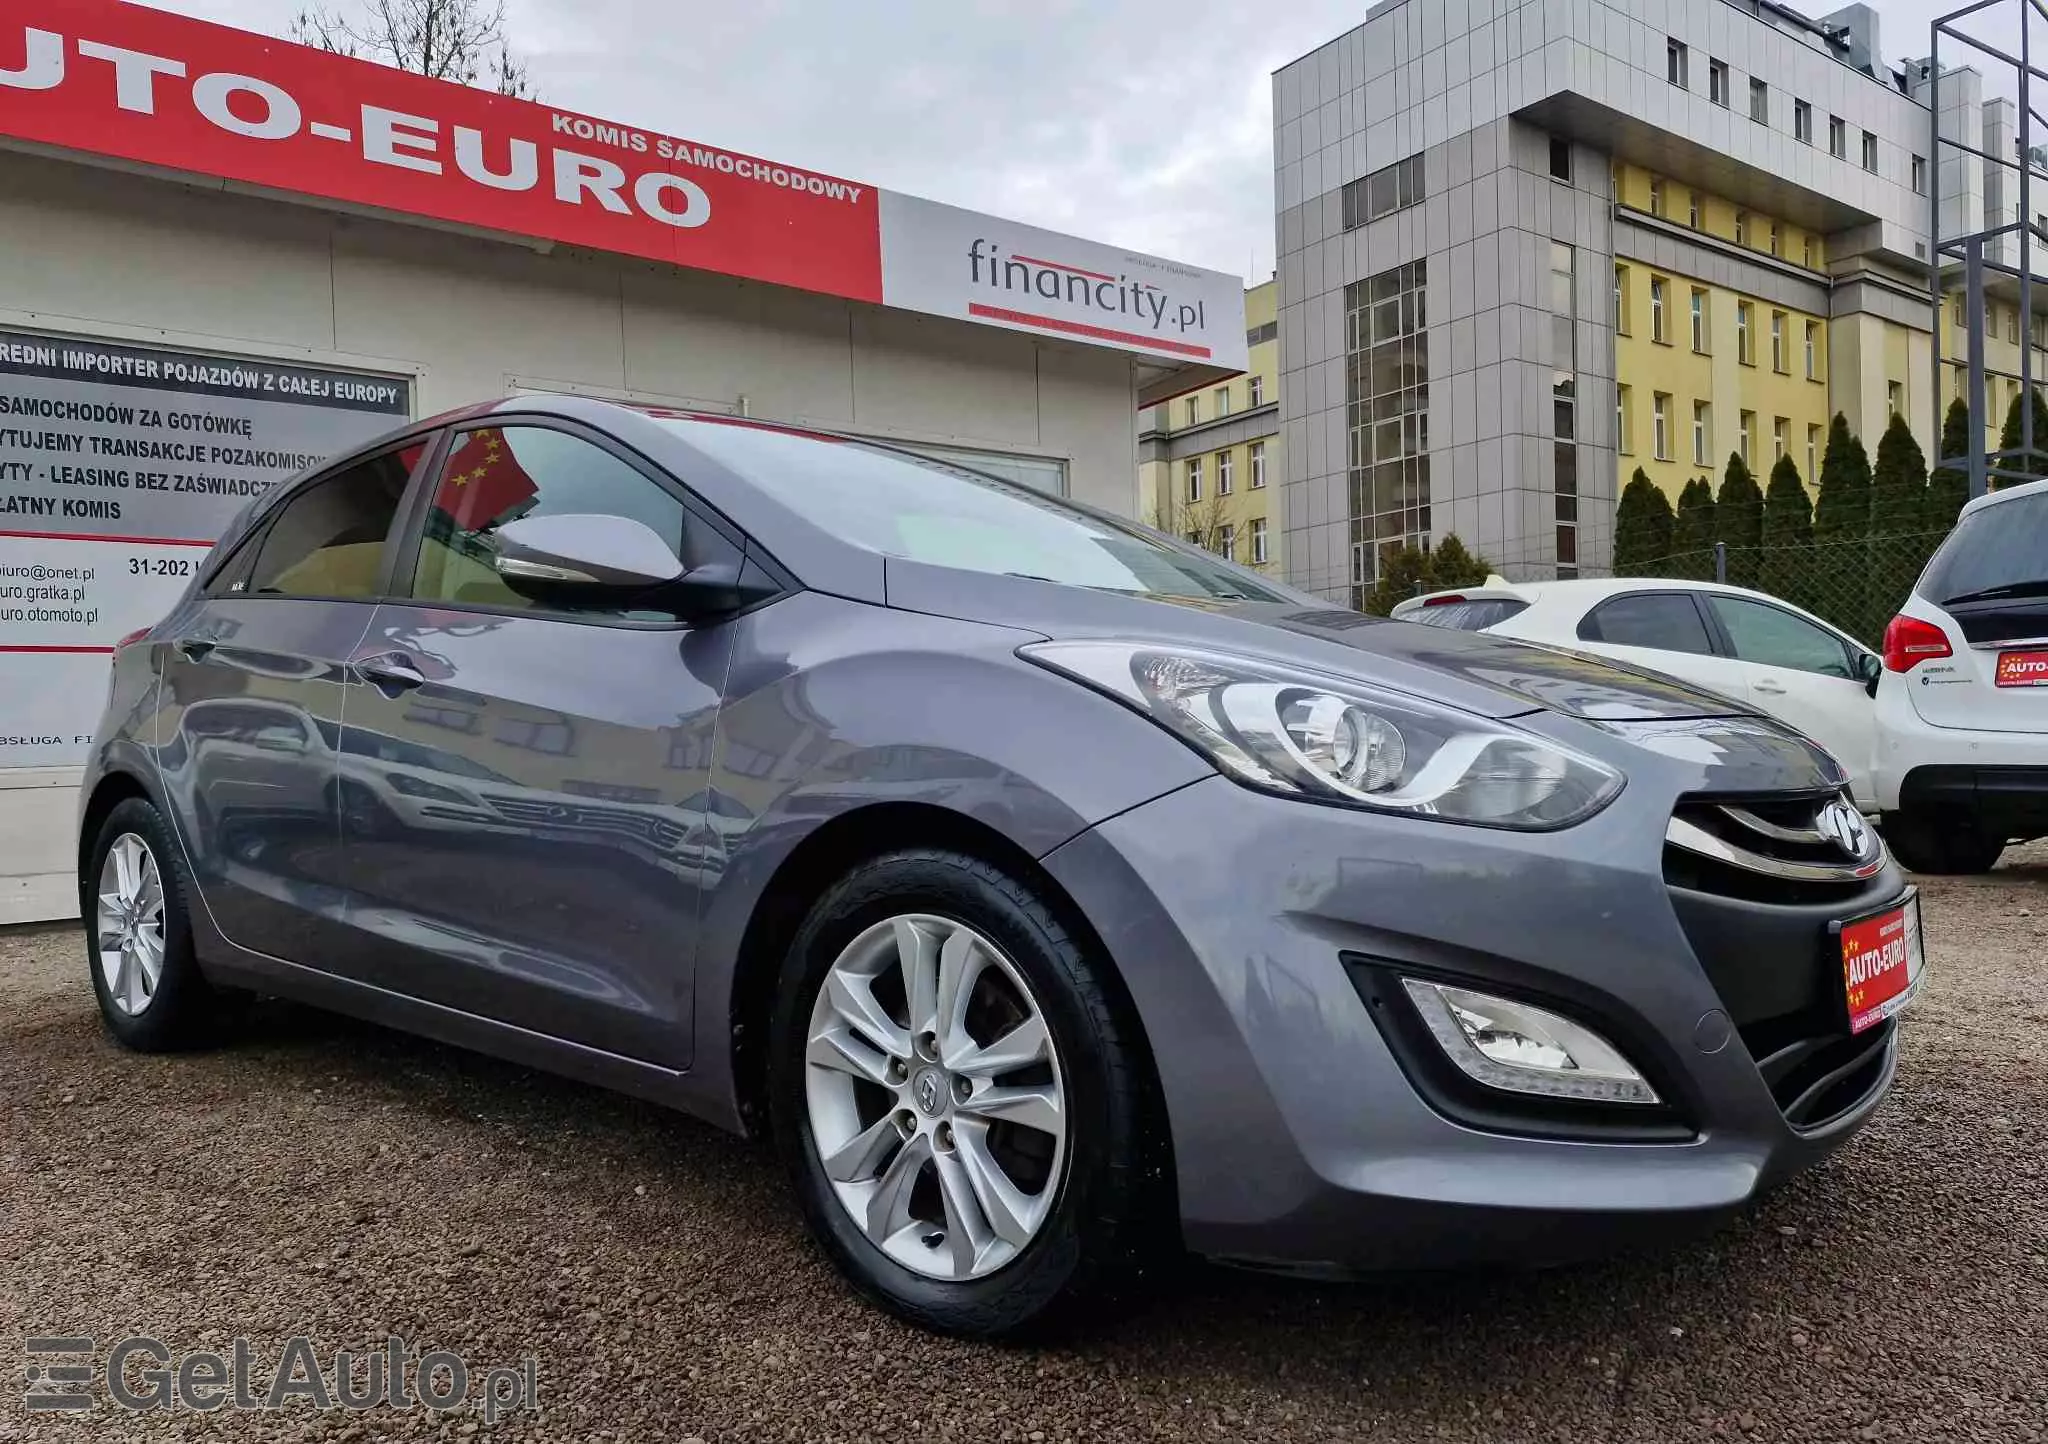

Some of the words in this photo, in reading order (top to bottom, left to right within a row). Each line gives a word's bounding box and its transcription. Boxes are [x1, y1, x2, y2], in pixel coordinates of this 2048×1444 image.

[552, 113, 648, 153] KOMIS
[657, 139, 862, 204] SAMOCHODOWY
[968, 238, 1206, 332] financity.pl
[63, 350, 158, 379] IMPORTER
[164, 360, 259, 390] POJAZDÓW
[263, 373, 275, 391] Z
[278, 375, 331, 398] CAŁEJ
[334, 381, 398, 404] EUROPY
[0, 395, 134, 425] SAMOCHODÓW
[139, 409, 163, 427] ZA
[168, 411, 253, 441] GOTÓWKĘ
[89, 436, 206, 463] TRANSAKCJE
[50, 465, 130, 488] LEASING
[135, 472, 169, 491] BEZ
[174, 473, 278, 497] ZAŚWIADCZ
[62, 498, 121, 519] KOMIS
[0, 563, 95, 582] iuro@onet.pl
[129, 558, 189, 576] 31-202
[1849, 936, 1905, 987] AUTO-EURO
